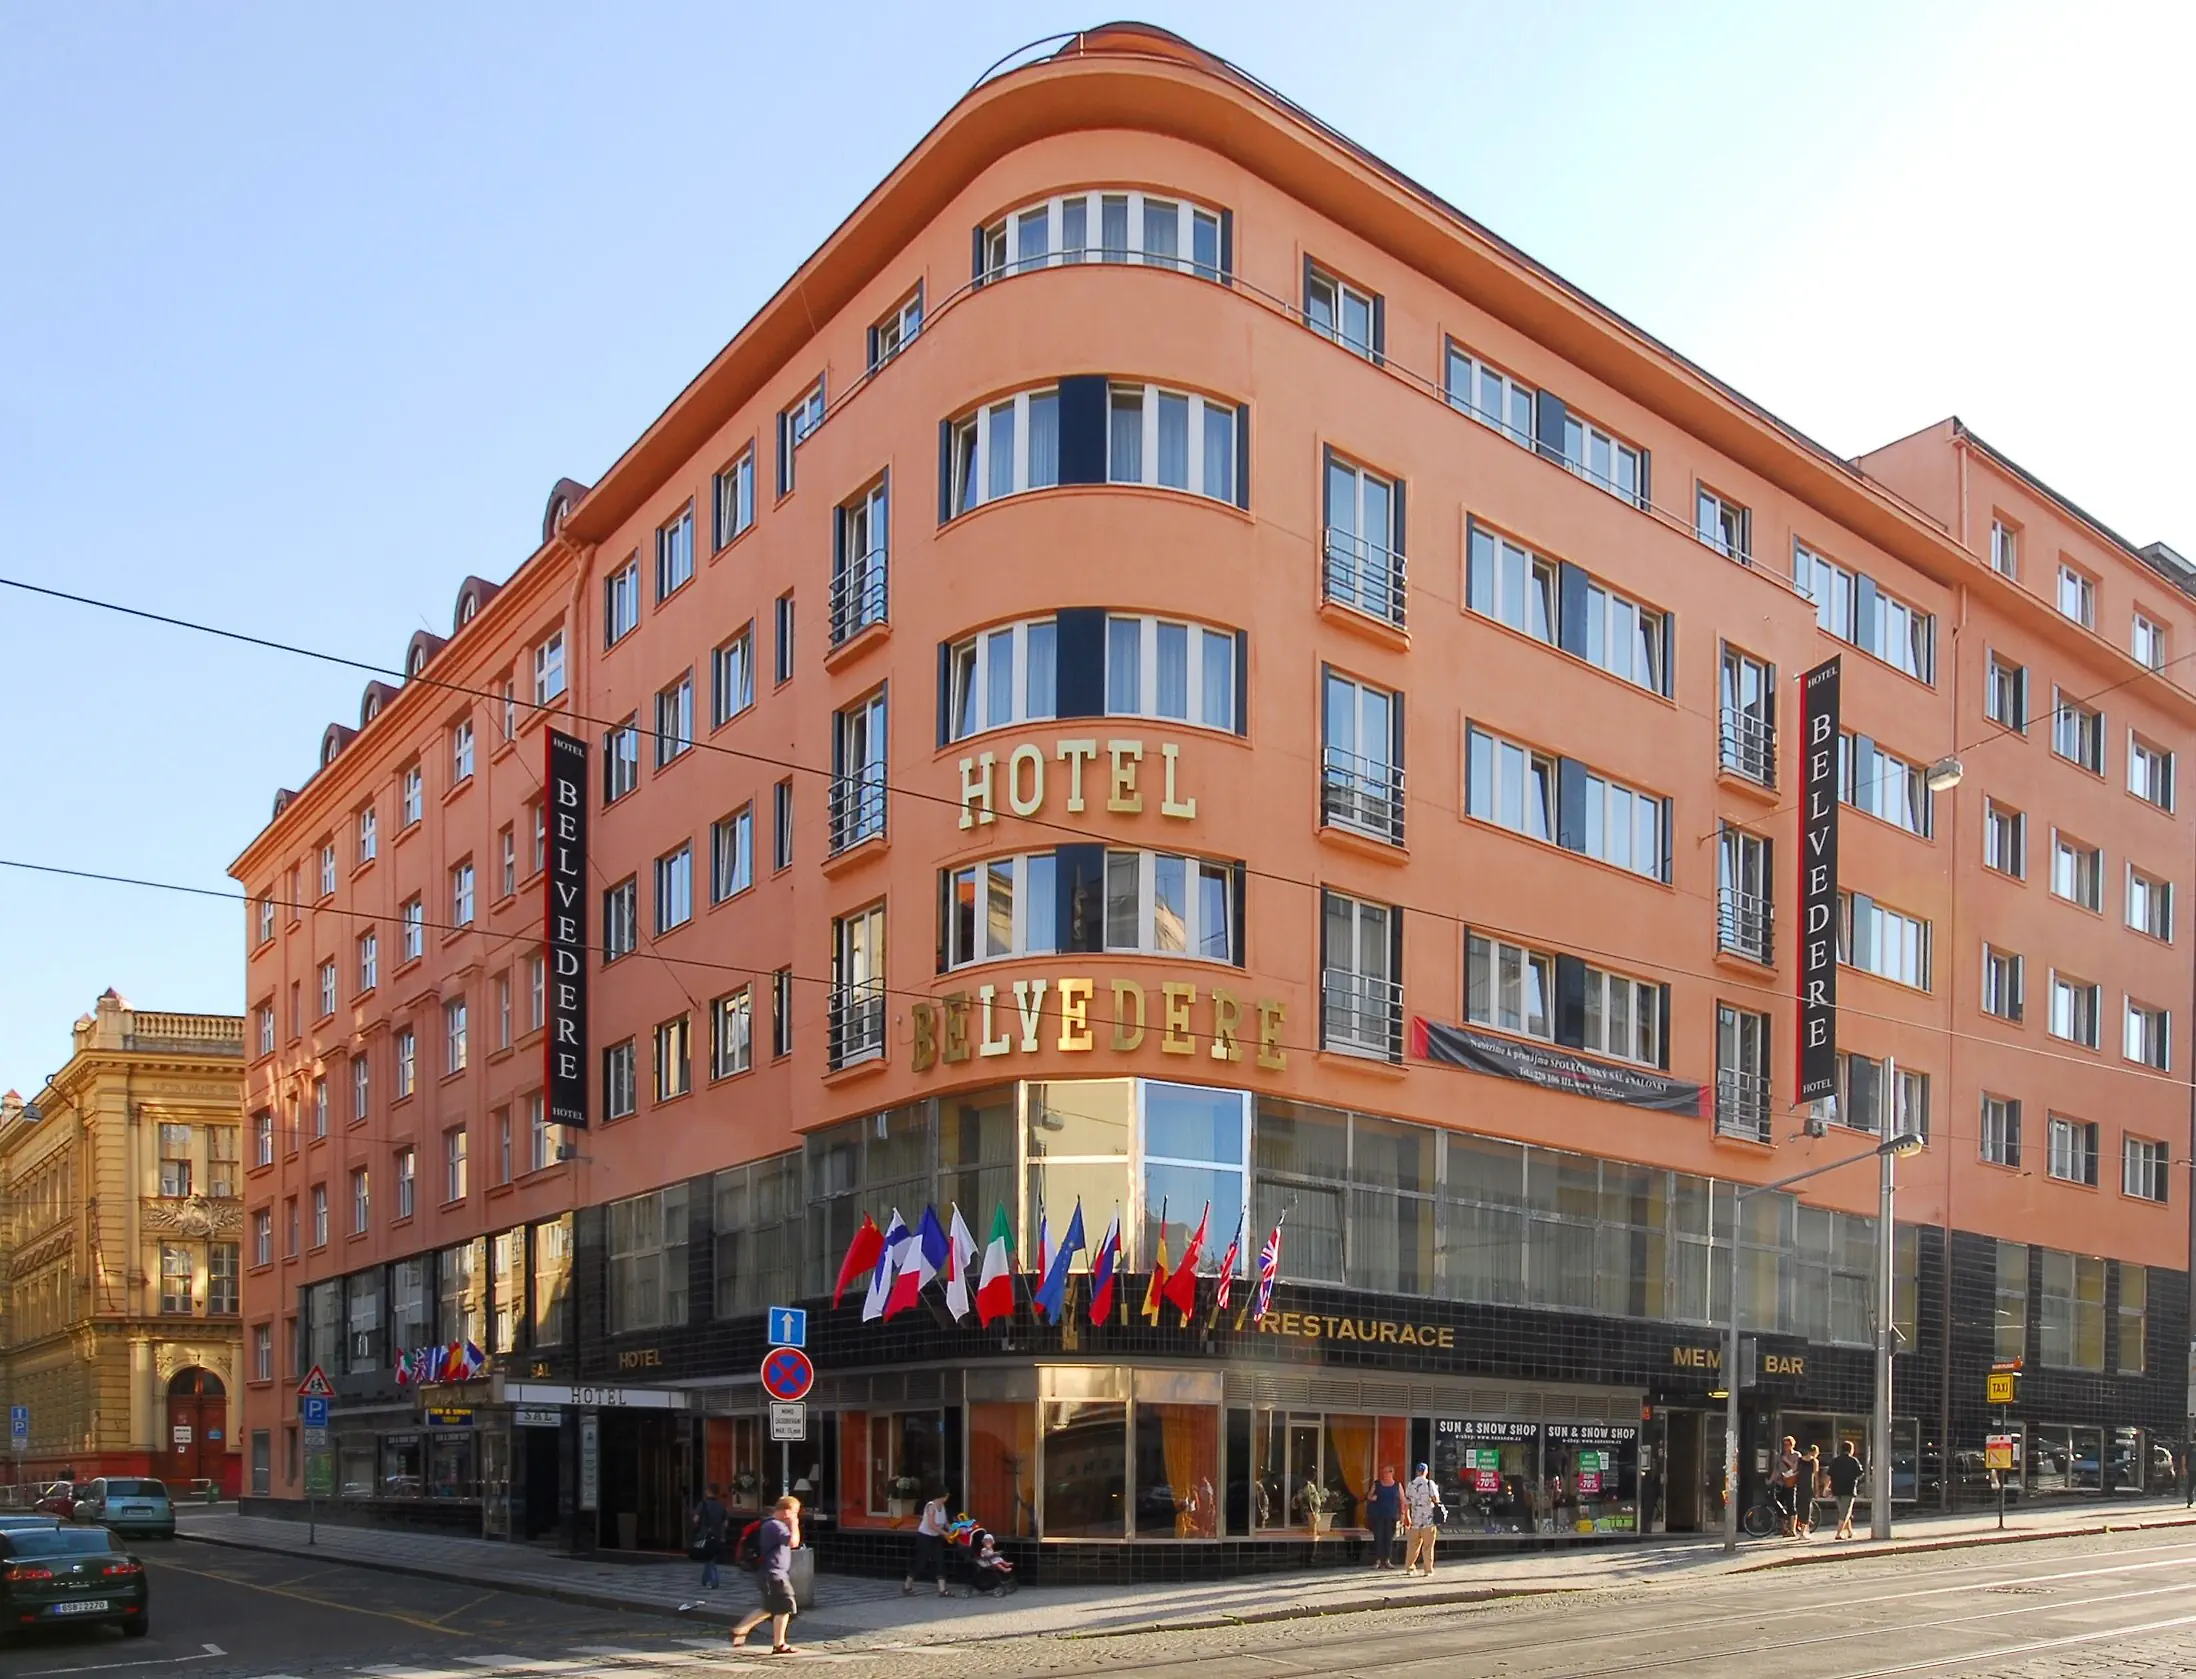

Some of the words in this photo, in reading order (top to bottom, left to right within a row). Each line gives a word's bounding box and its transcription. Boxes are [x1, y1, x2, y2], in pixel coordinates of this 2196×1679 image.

[1807, 666, 1838, 689] HOTEL
[553, 737, 585, 758] HOTEL
[958, 739, 1196, 830] HOTEL
[1808, 713, 1831, 1047] BELVEDERE
[555, 777, 580, 1080] BELVEDERE
[911, 978, 1288, 1073] BELVEDERE
[1803, 1078, 1833, 1094] HOTEL
[552, 1107, 585, 1121] HOTEL
[1259, 1311, 1455, 1349] RESTAURACE
[619, 1350, 662, 1369] HOTEL
[1765, 1355, 1805, 1375] BAR
[571, 1387, 628, 1406] HOTEL
[1993, 1383, 2009, 1394] TAXI
[309, 1401, 323, 1418] P
[1440, 1421, 1461, 1433] SUN
[1465, 1422, 1473, 1433] &
[1476, 1423, 1507, 1435] SNOW
[1510, 1424, 1537, 1436] SHOP
[1548, 1426, 1568, 1438] SUN
[1571, 1427, 1579, 1438] &
[1581, 1428, 1608, 1439] SNOW
[1611, 1429, 1635, 1439] SHOP
[1477, 1478, 1496, 1488] -70%
